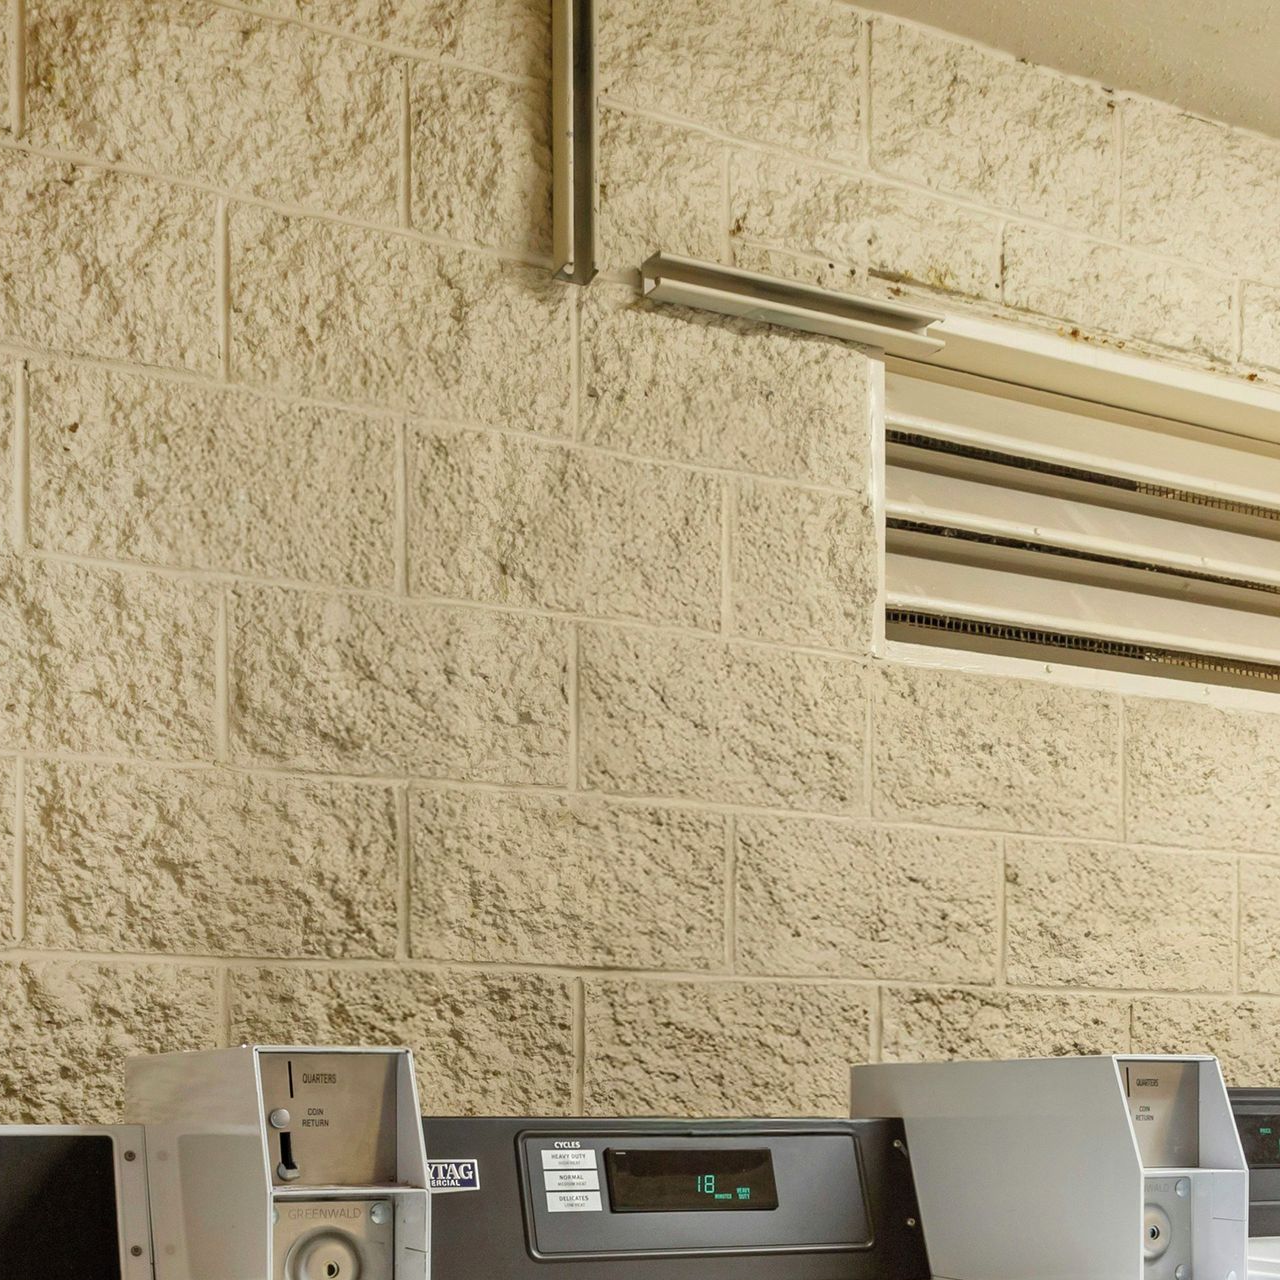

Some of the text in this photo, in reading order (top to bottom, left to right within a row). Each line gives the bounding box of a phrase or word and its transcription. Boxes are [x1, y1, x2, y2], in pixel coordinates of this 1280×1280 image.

[302, 1073, 337, 1084] QUARTERS
[307, 1107, 324, 1116] COIN
[302, 1119, 329, 1127] RETURN
[554, 1141, 581, 1149] CYCLES
[427, 1163, 473, 1180] YTAG
[698, 1175, 715, 1193] 18
[287, 1207, 362, 1219] GREENWALD
